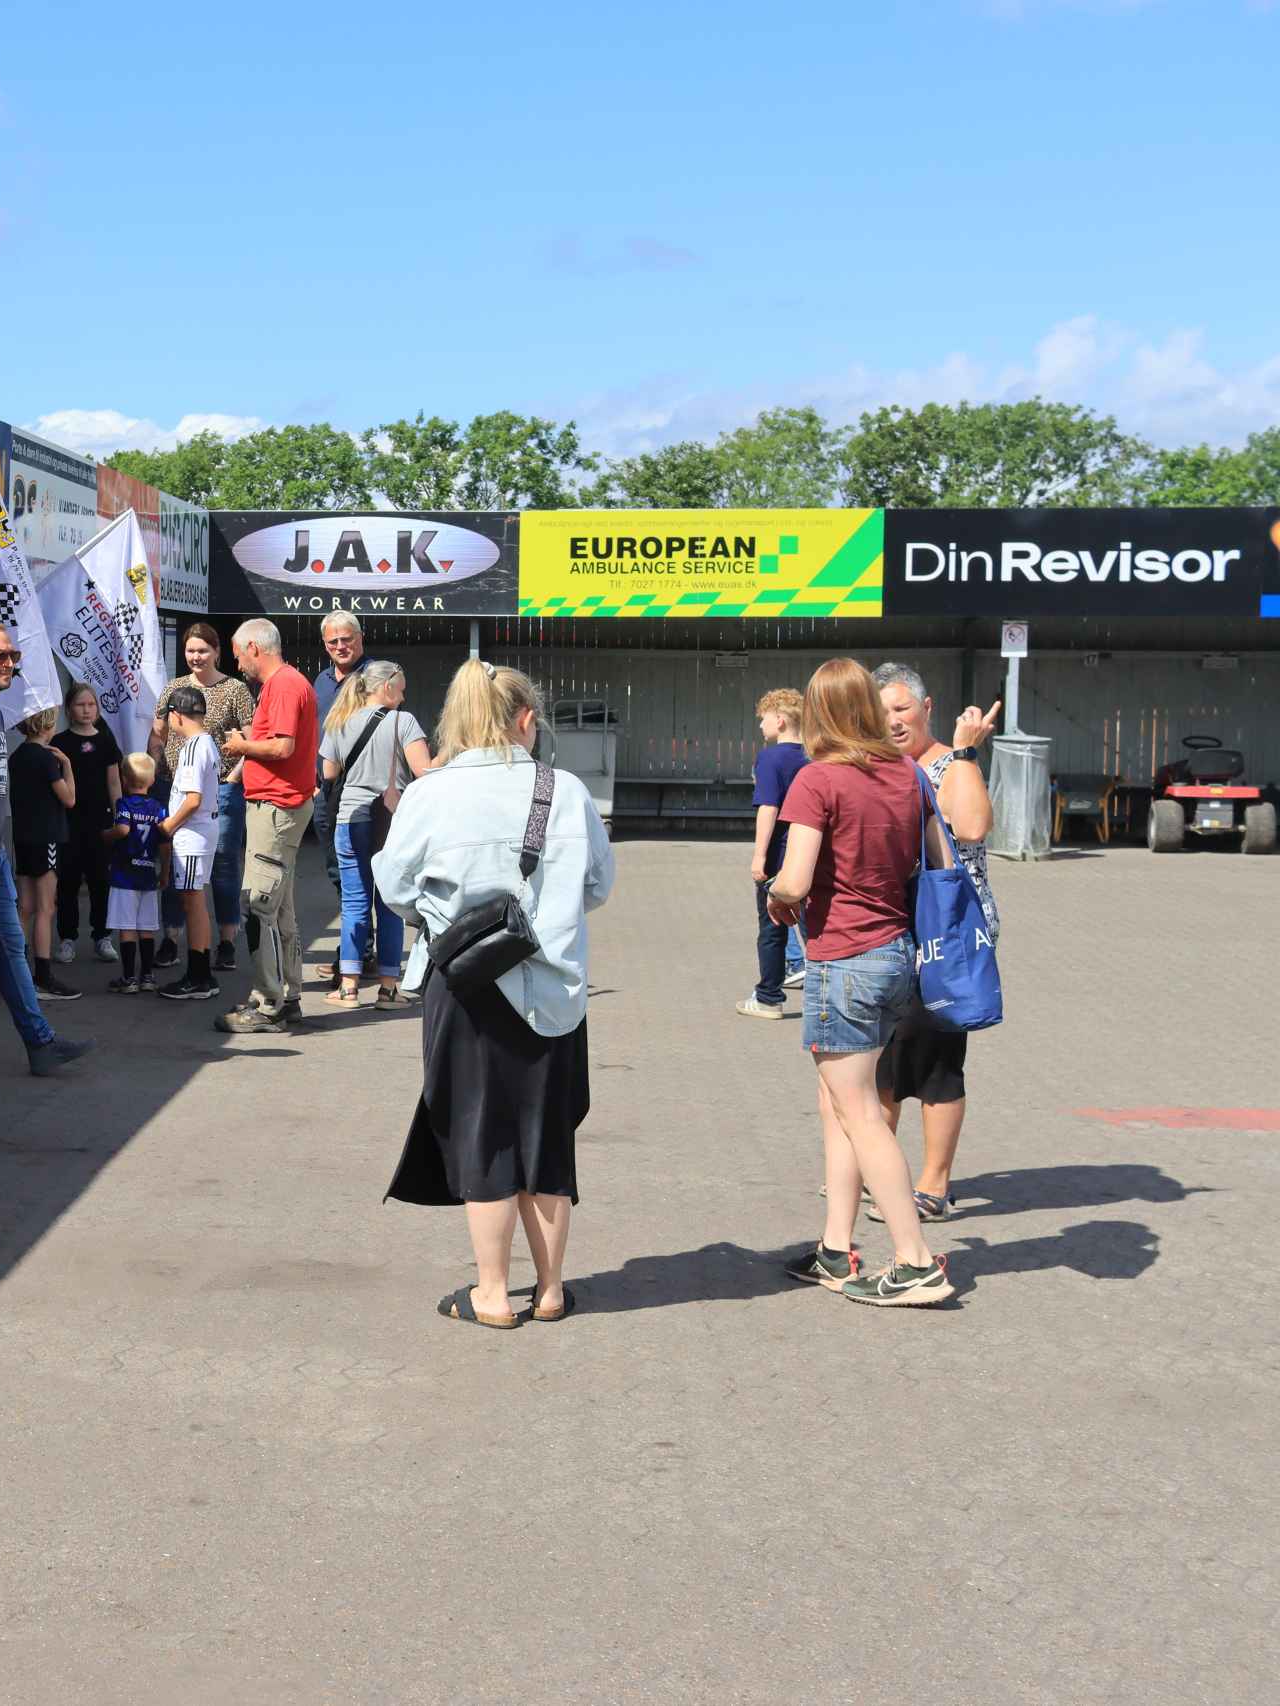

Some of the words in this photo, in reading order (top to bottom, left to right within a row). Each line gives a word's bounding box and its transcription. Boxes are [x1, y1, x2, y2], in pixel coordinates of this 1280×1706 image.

[283, 530, 455, 574] J.A.K.
[569, 536, 756, 559] EUROPEAN
[569, 561, 676, 575] AMBULANCE
[682, 561, 756, 575] SERVICE
[905, 542, 1241, 583] DinRevisor
[658, 579, 681, 590] 1774
[284, 596, 445, 610] WORKWEAR
[85, 592, 118, 648] REGIO
[114, 651, 141, 695] VARD
[136, 823, 151, 844] 7
